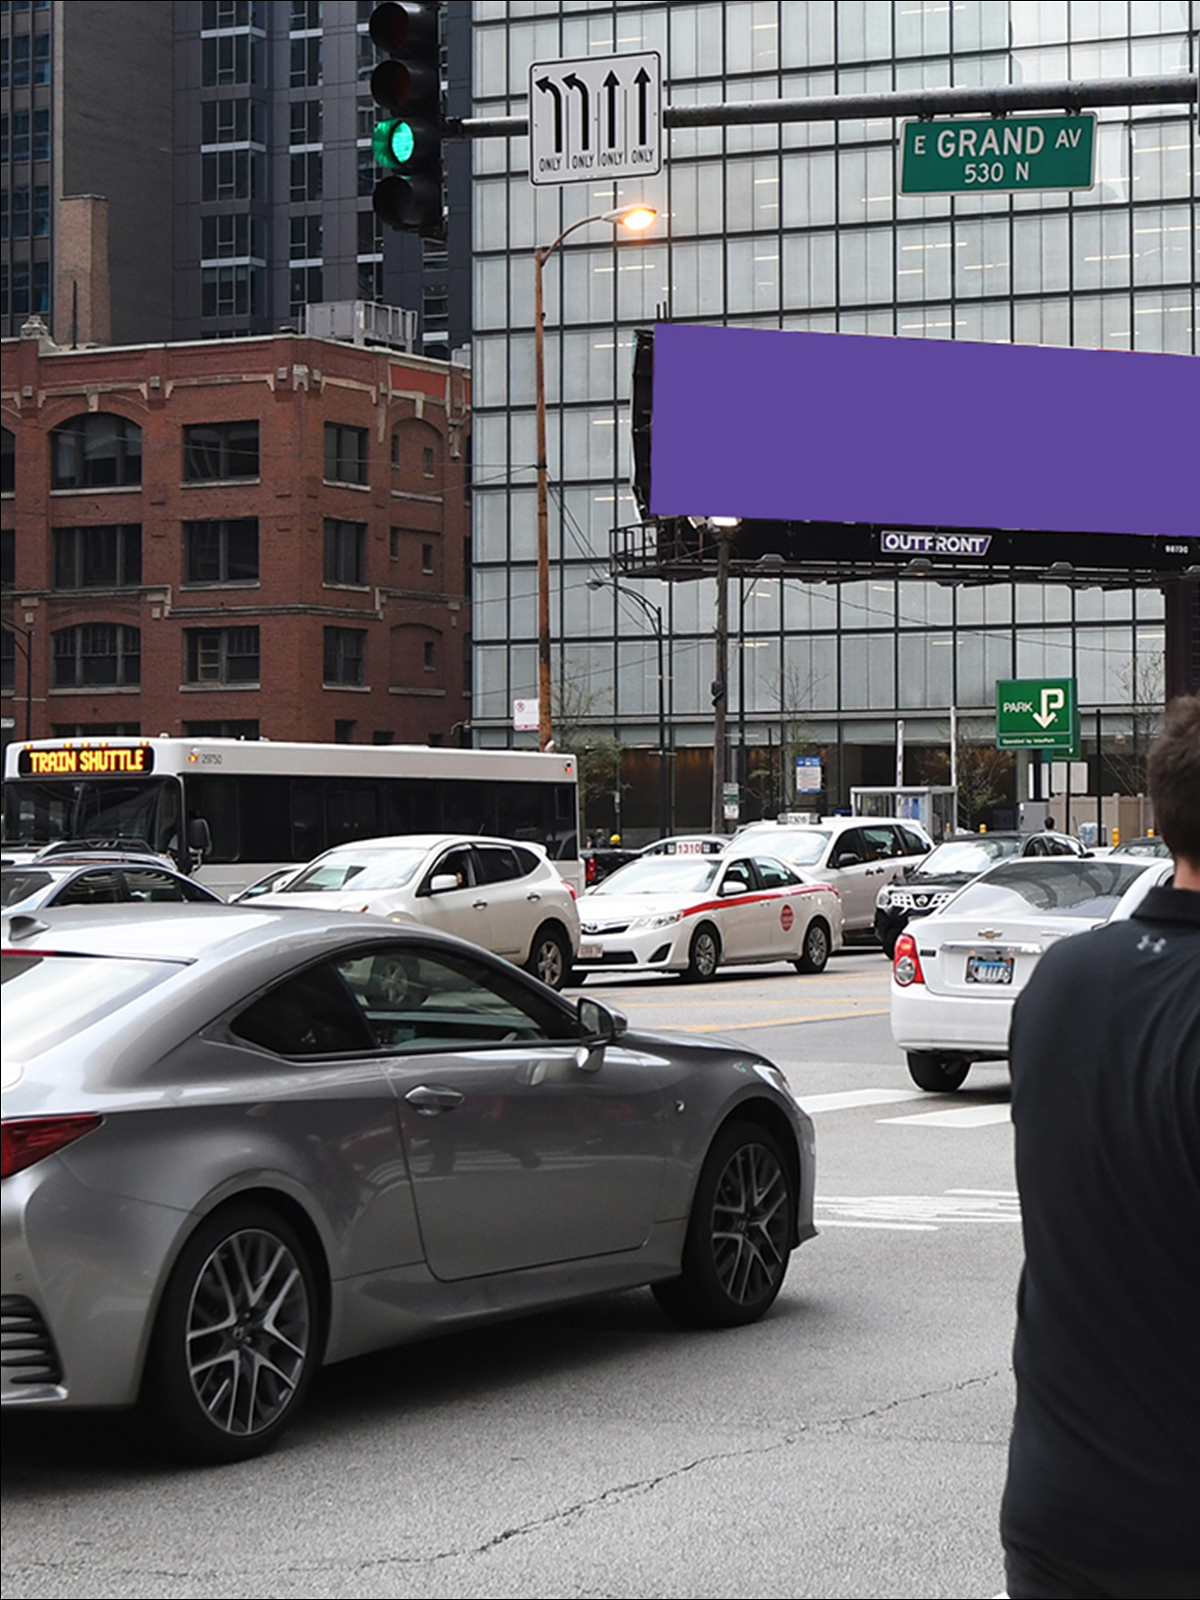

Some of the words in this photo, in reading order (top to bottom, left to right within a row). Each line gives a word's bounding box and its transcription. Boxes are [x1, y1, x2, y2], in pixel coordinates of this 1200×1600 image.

[914, 135, 926, 155] E
[937, 126, 1045, 158] GRAND
[1055, 128, 1082, 149] AV
[539, 158, 562, 172] ONLY
[572, 154, 595, 169] ONLY
[601, 152, 624, 166] ONLY
[631, 149, 654, 164] ONLY
[964, 162, 1004, 183] 530
[1016, 162, 1029, 181] N
[885, 534, 985, 552] OUTFRONT
[1003, 702, 1033, 713] PARK
[29, 751, 76, 773] TRAIN
[79, 749, 144, 772] SHUTTLE
[678, 843, 702, 854] 1310
